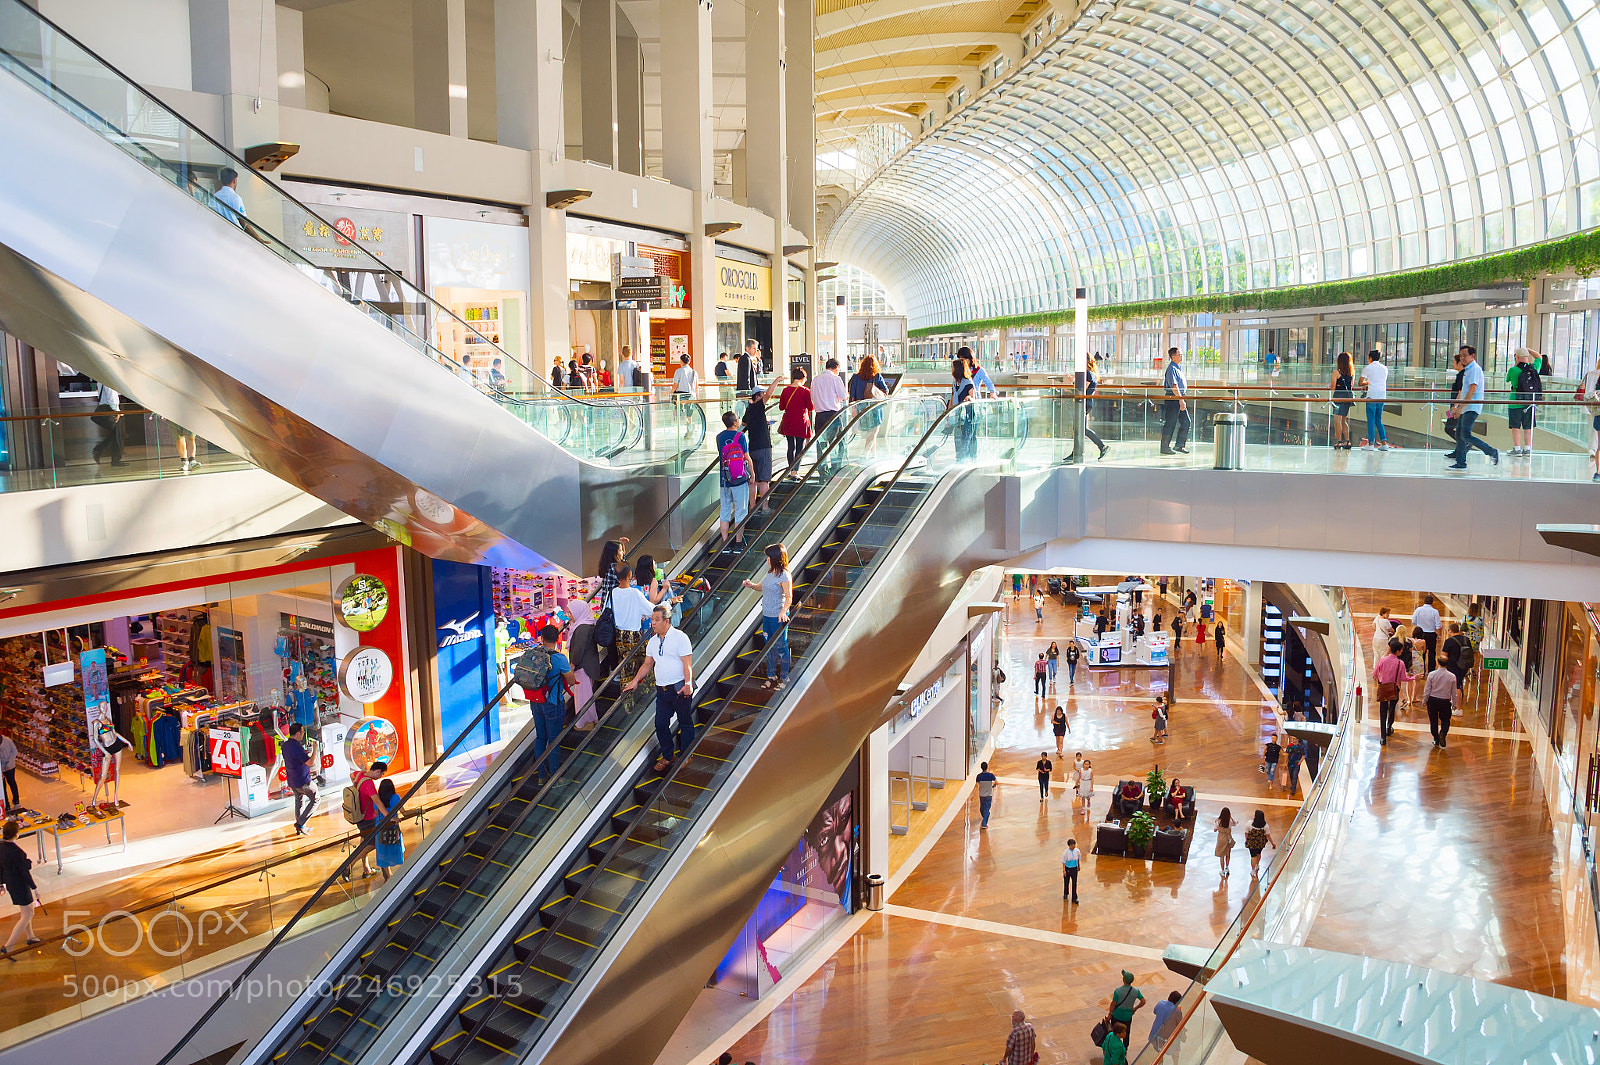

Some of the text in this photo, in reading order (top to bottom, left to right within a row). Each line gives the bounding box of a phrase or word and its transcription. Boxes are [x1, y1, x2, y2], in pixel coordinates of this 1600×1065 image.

[724, 292, 755, 301] cosmetics
[299, 621, 332, 634] SALOMON
[1487, 659, 1504, 668] EXIT
[212, 739, 241, 770] 40
[75, 803, 85, 813] 20
